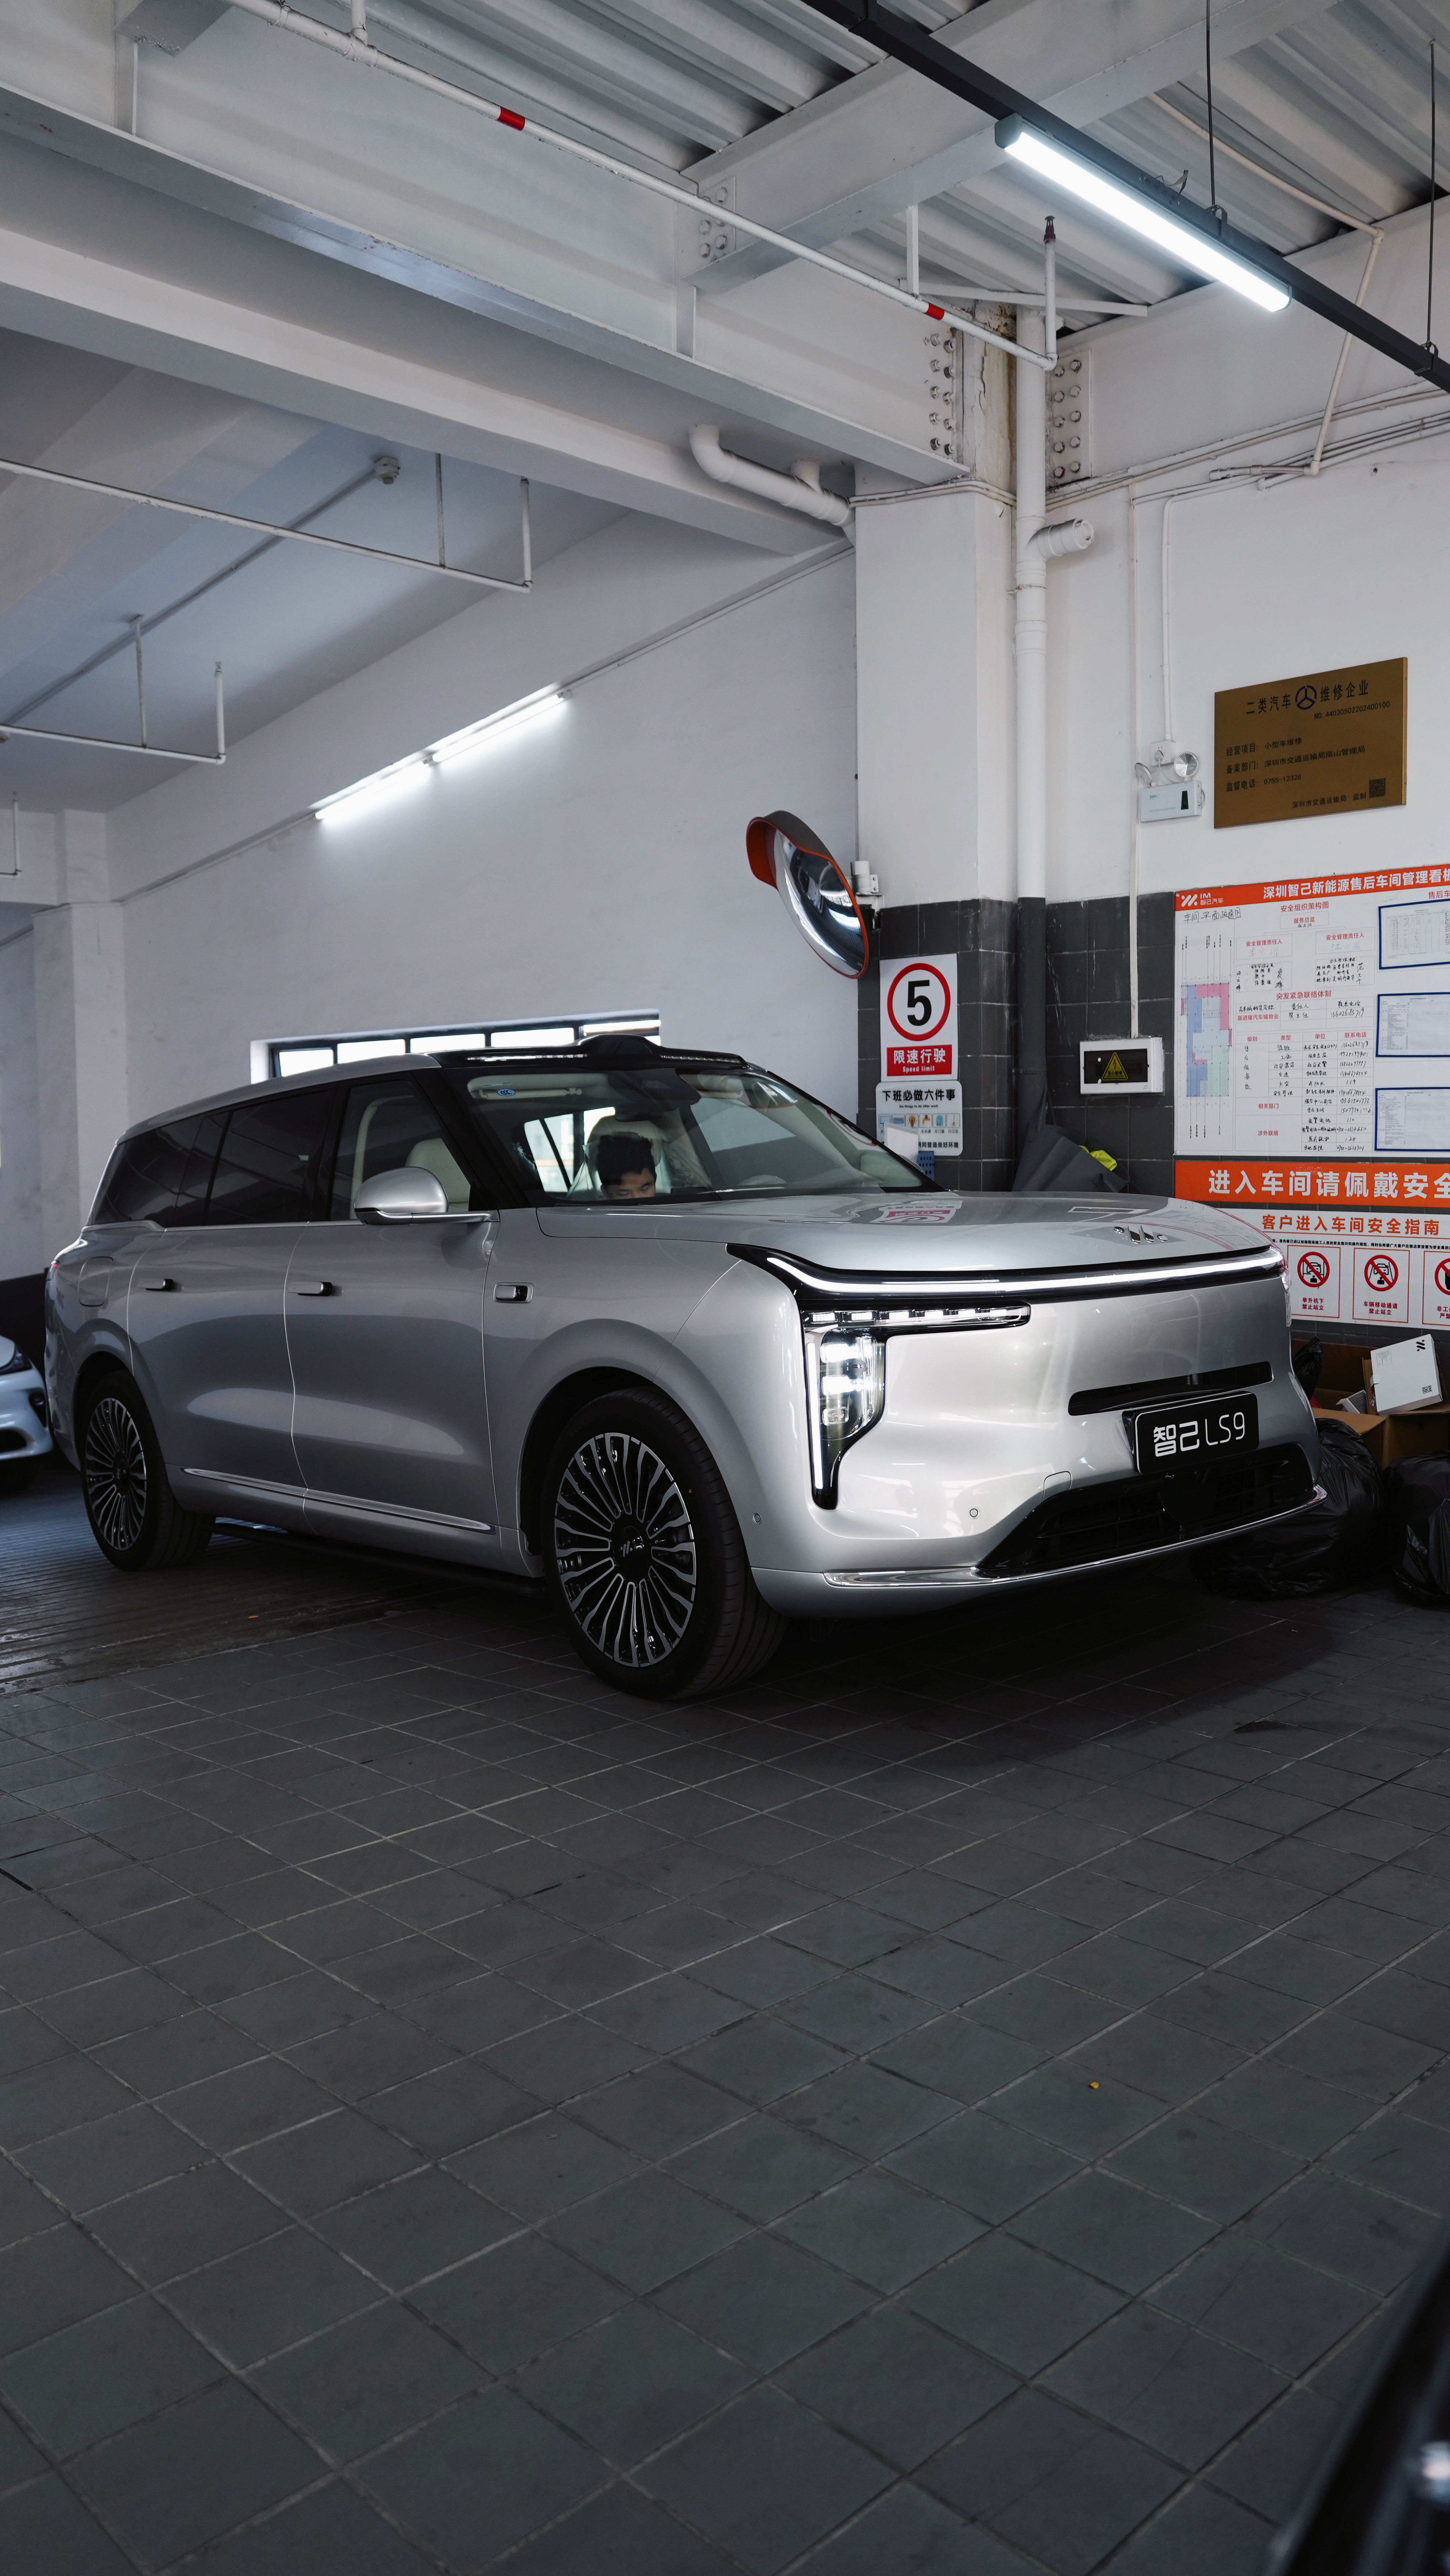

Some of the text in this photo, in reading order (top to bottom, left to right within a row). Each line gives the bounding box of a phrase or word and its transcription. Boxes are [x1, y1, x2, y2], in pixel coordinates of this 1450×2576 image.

[1246, 680, 1368, 714] 二类汽车 维修企业
[1264, 737, 1302, 749] 小型车维修
[1264, 746, 1365, 768] 深圳市交通运输局南山管理局
[1264, 774, 1301, 785] 0755-12328
[1292, 793, 1367, 808] 深圳市交通运输局 监制
[1246, 939, 1282, 947] 安全管理责任人
[1326, 932, 1365, 941] 安全管理责任人
[1276, 990, 1331, 1000] 突发紧急联络体制
[907, 979, 932, 1026] 5
[1237, 1013, 1279, 1022] 嘉进隆汽车城物业
[893, 1047, 946, 1064] 限速行驶
[882, 1088, 956, 1101] 下班必做六件事
[1208, 1169, 1450, 1199] 进入车间请佩戴安全
[1262, 1213, 1440, 1236] 客户进入车间安全指南
[1363, 1301, 1398, 1309] 车辆移动通道
[1153, 1412, 1246, 1457] 智己 LS9
